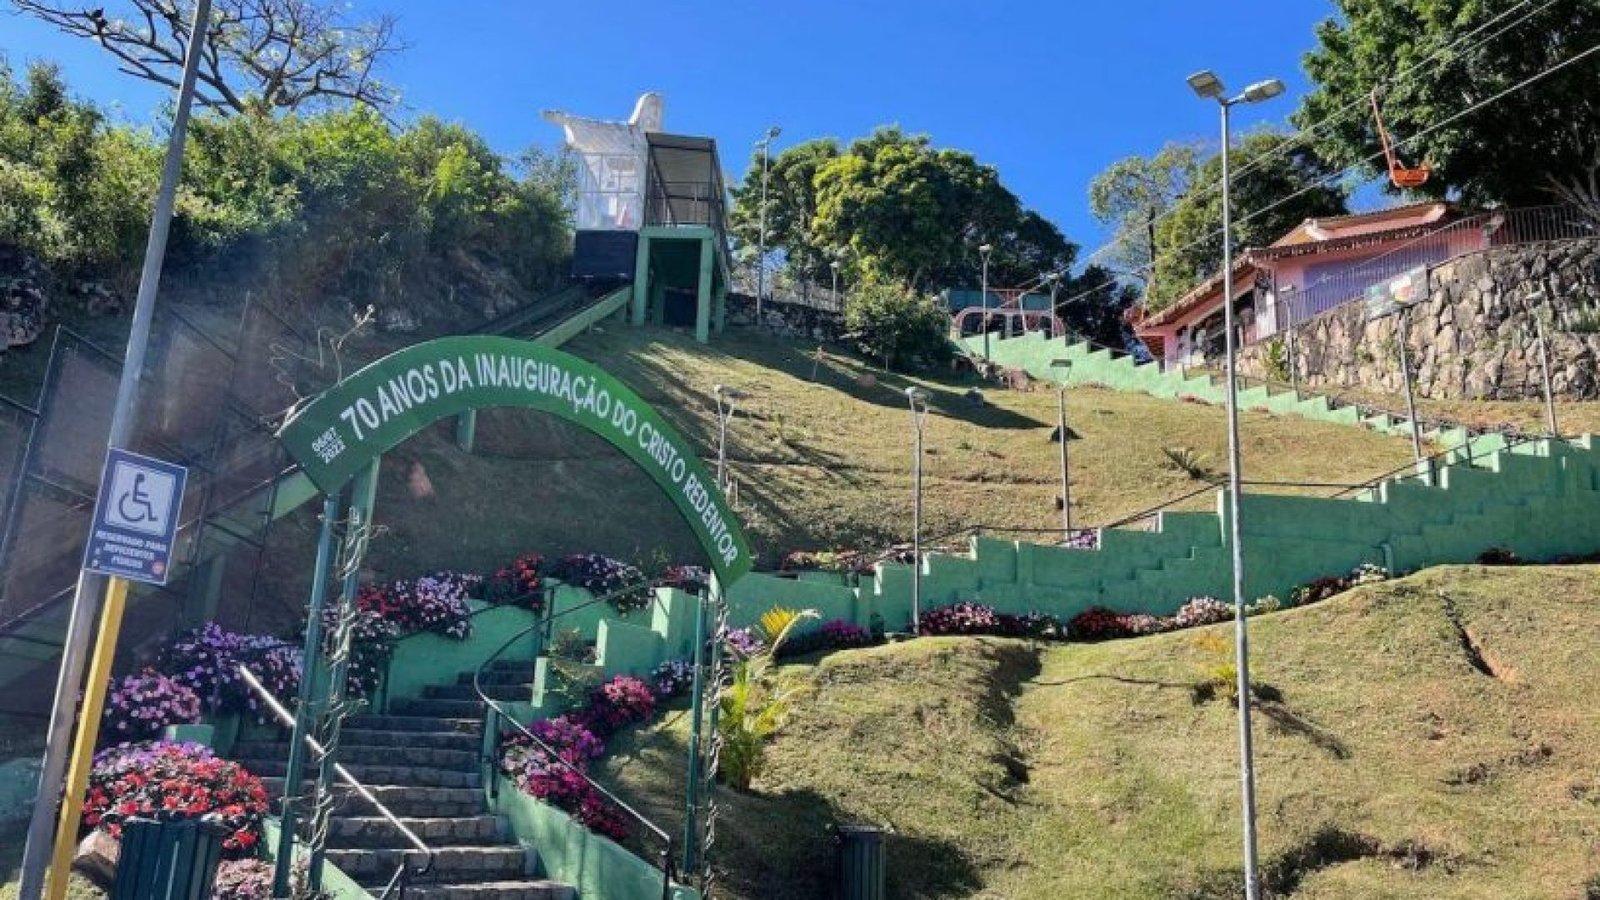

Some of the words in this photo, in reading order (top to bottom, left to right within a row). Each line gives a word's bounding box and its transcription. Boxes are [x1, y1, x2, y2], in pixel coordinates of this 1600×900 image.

[340, 397, 380, 440] 70
[377, 364, 439, 422] ANOS
[439, 356, 474, 394] DA
[474, 352, 610, 419] INAUGURAÇÃO
[612, 398, 637, 436] DO
[638, 421, 686, 483] CRISTO
[683, 472, 738, 567] REDENTOR
